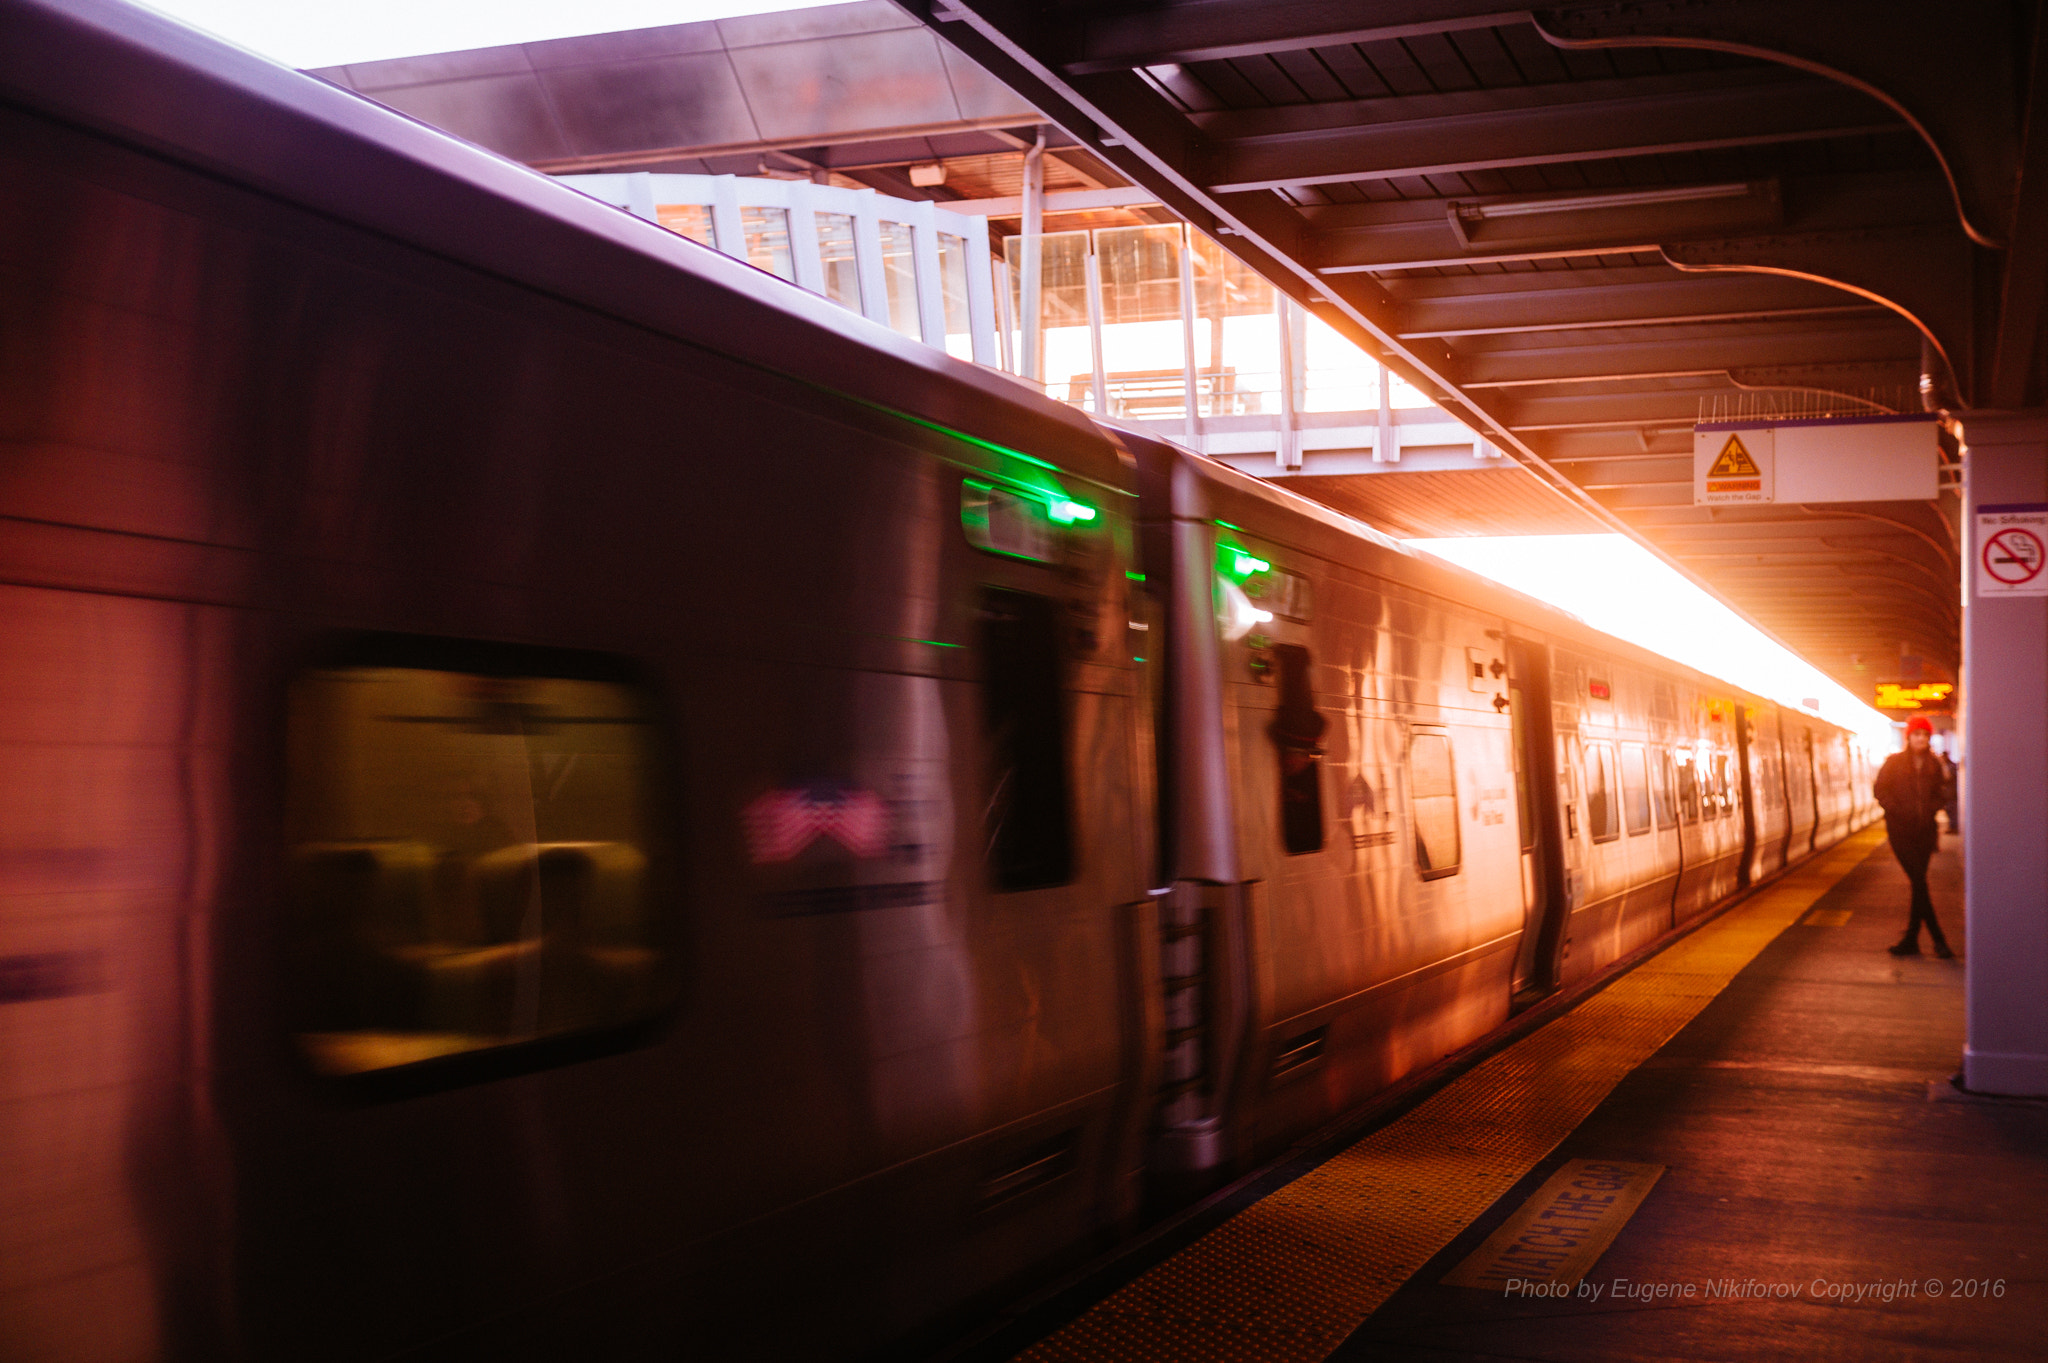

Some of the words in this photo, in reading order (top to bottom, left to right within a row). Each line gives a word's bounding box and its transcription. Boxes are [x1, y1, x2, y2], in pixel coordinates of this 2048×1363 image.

[1707, 494, 1730, 502] Watch
[1731, 493, 1743, 501] the
[1745, 492, 1762, 502] Gap
[1717, 481, 1760, 490] WARNING
[1571, 1164, 1637, 1192] GAP
[1540, 1191, 1616, 1222] THE
[1477, 1223, 1591, 1283] WATCH
